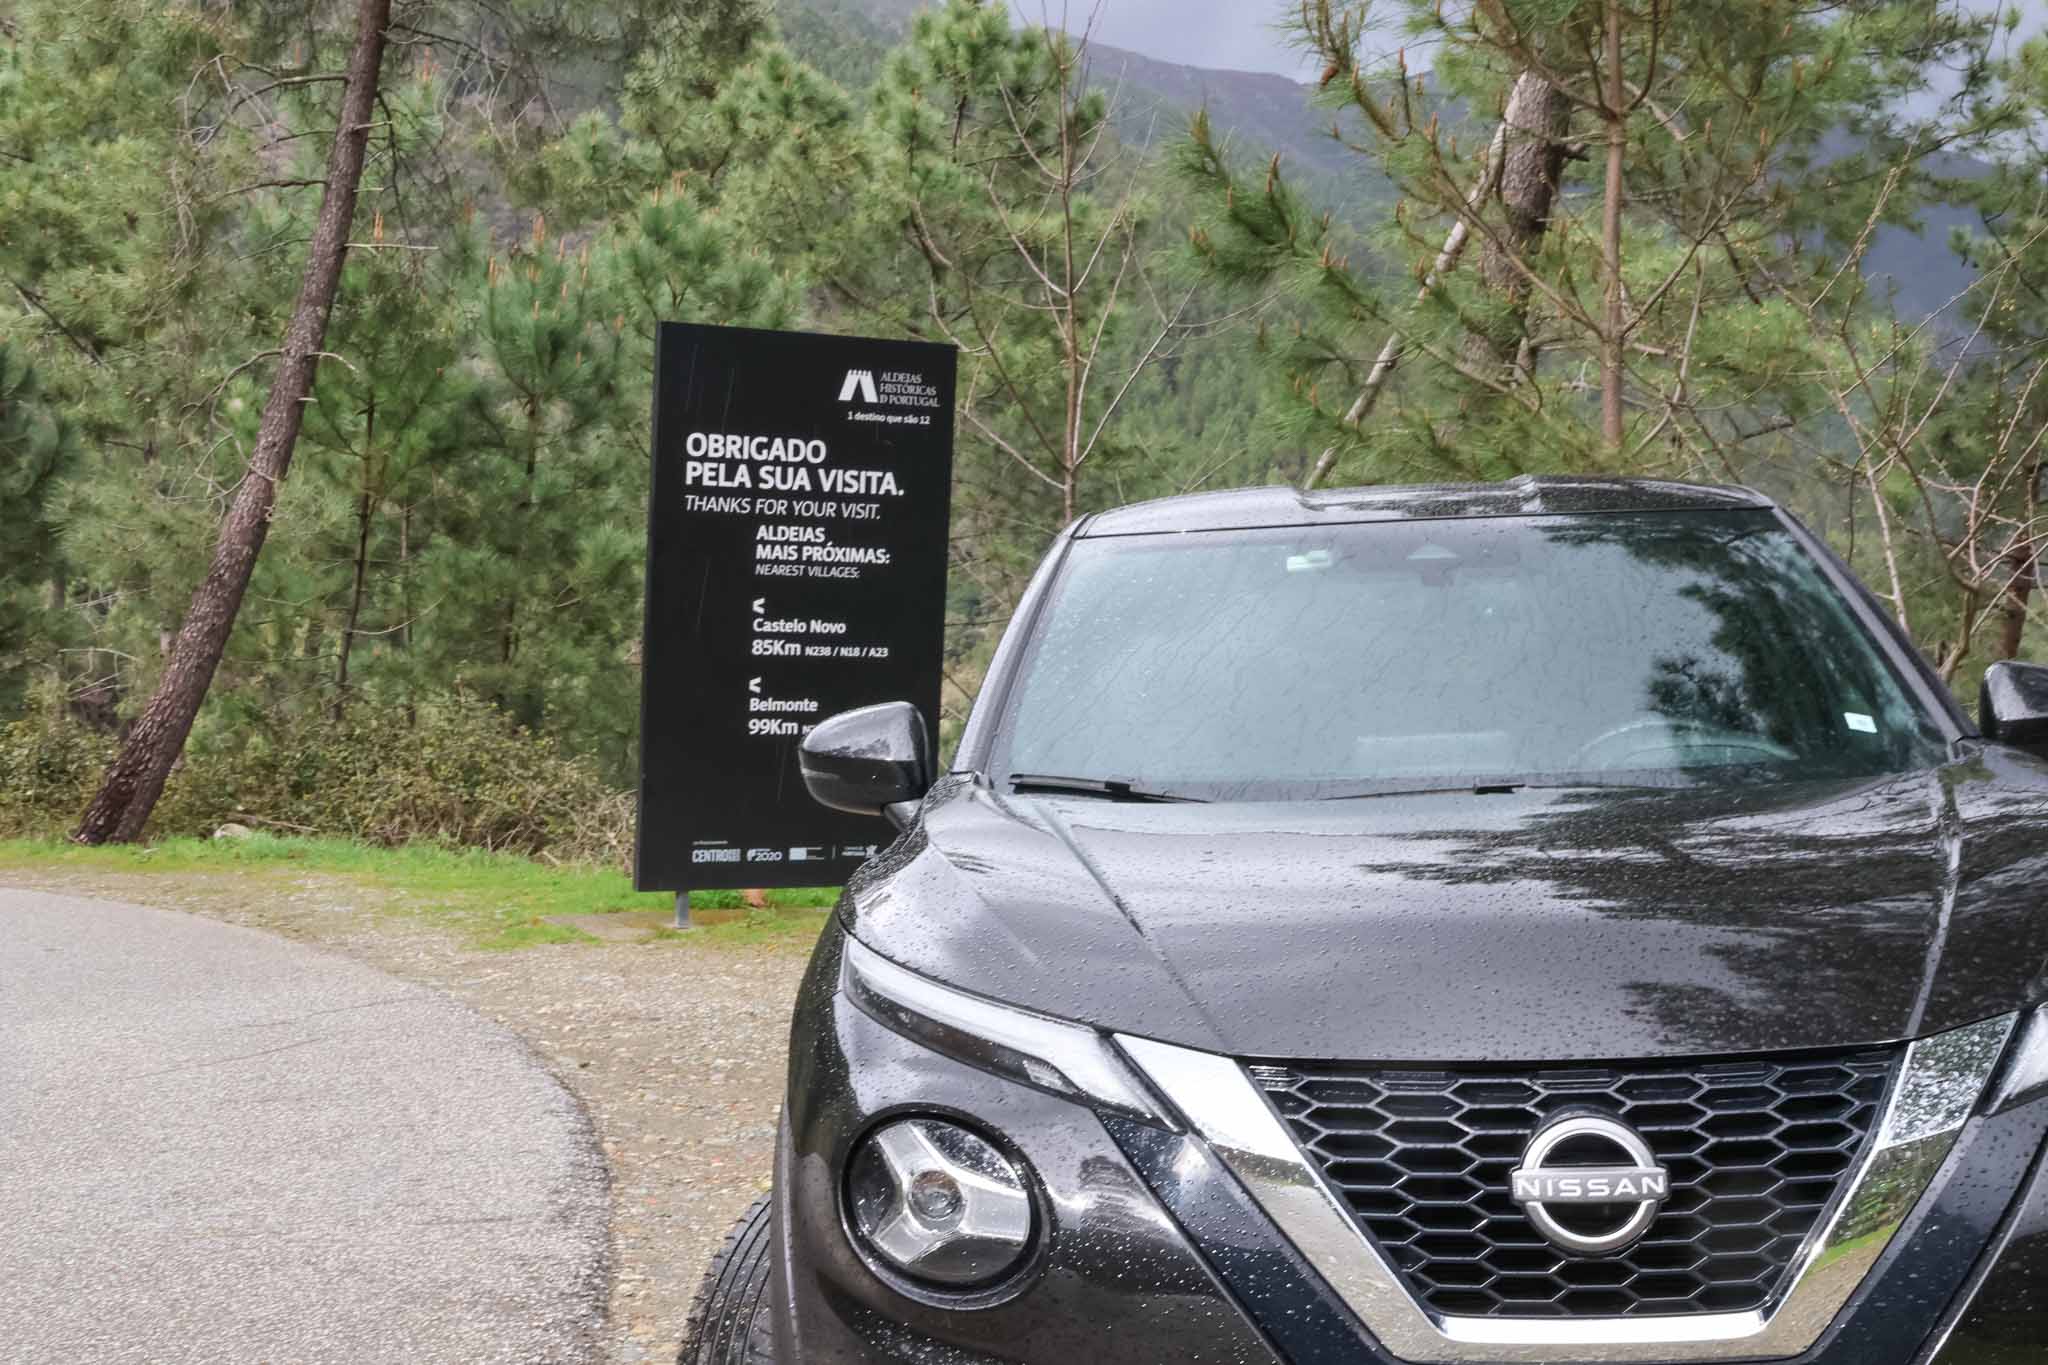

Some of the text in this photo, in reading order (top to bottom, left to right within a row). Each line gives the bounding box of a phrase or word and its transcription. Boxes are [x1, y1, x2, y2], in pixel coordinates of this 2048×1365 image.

[881, 371, 922, 384] ALDEIAS
[889, 395, 940, 408] PORTUGAL
[854, 411, 886, 422] destino
[886, 415, 903, 425] que
[919, 415, 931, 425] 12
[686, 432, 827, 464] OBRIGADO
[685, 460, 905, 496] PELA SUA VISITA.
[685, 494, 881, 521] THANKS FOR YOUR VISIT.
[756, 524, 826, 543] ALDEIAS
[756, 541, 891, 565] MAIS PRÓXIMAS:
[755, 563, 861, 579] NEAREST VILLAGES:
[752, 617, 847, 635] Castelo Novo
[751, 639, 802, 657] 85Km
[804, 646, 832, 657] N238
[840, 647, 861, 657] N18
[868, 647, 889, 658] A23
[749, 697, 819, 713] Belmonte
[748, 718, 799, 736] 99Km
[1516, 1175, 1664, 1198] NISSAN
